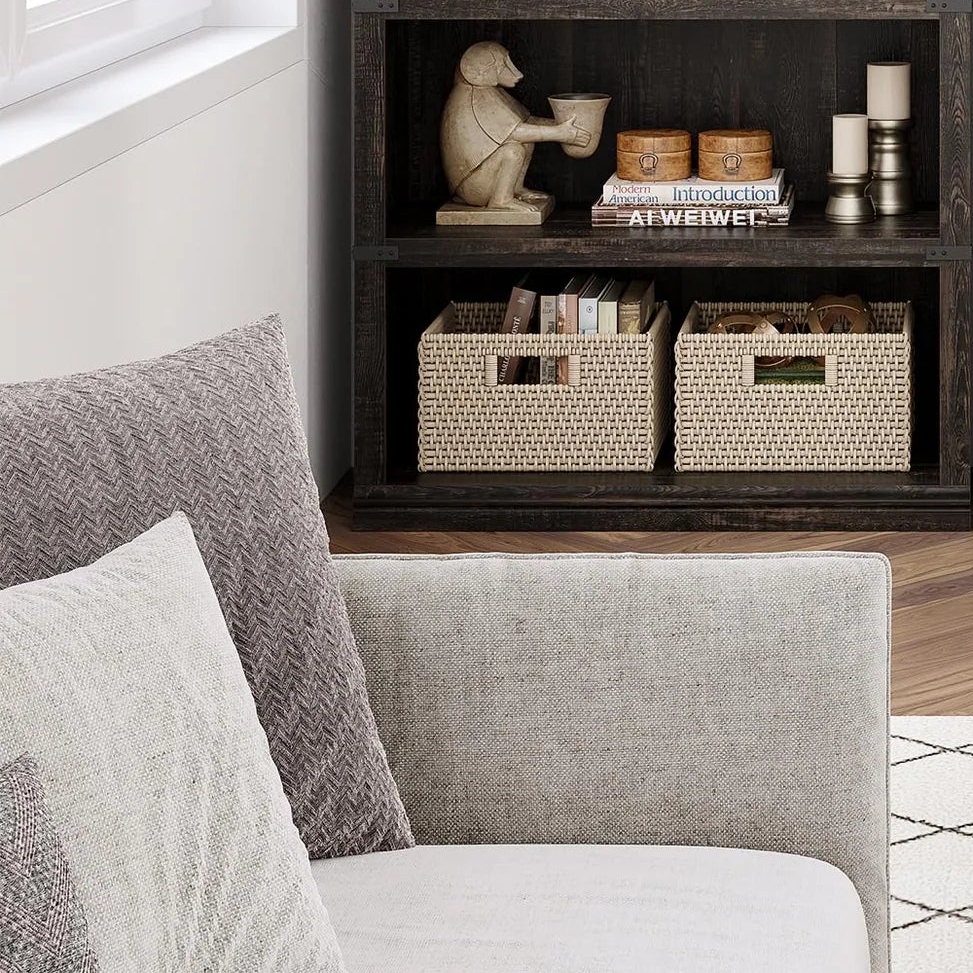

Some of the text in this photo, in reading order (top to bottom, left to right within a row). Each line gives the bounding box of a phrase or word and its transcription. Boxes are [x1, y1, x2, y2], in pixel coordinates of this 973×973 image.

[612, 185, 651, 194] Modern
[672, 186, 777, 202] Introduction
[608, 194, 659, 203] American
[629, 210, 653, 226] AI
